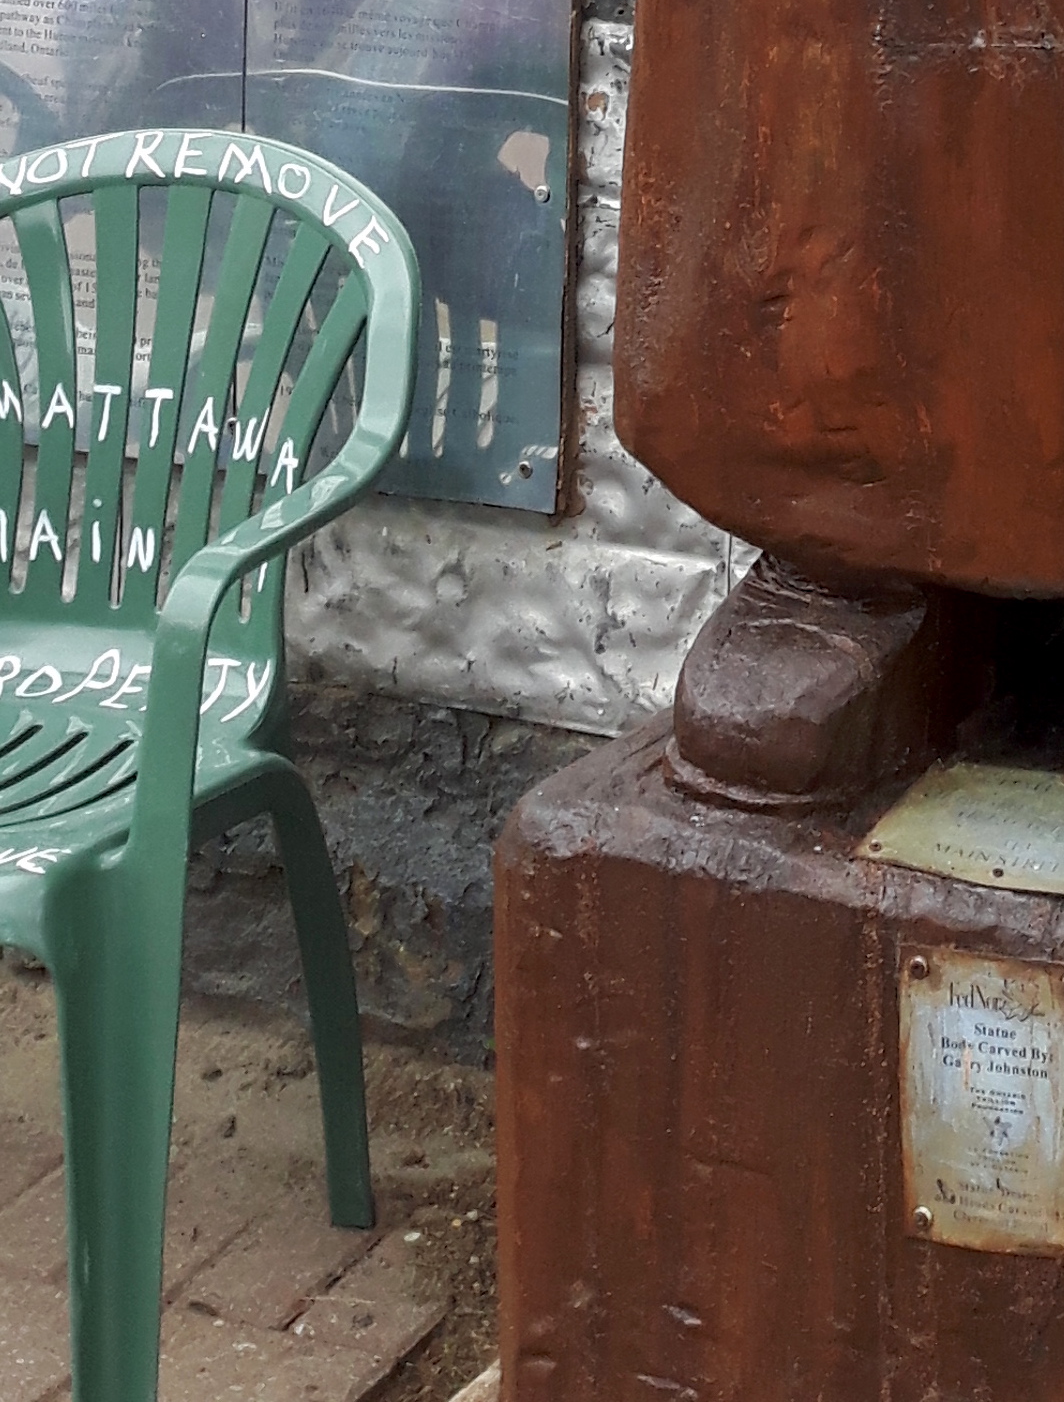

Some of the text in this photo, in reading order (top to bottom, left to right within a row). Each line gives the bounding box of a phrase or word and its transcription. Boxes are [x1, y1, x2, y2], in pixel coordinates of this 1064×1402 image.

[125, 130, 391, 270] REMOVE
[973, 1022, 1018, 1040] Statue
[978, 1041, 1027, 1060] Carved
[986, 1060, 1048, 1080] Johnston
